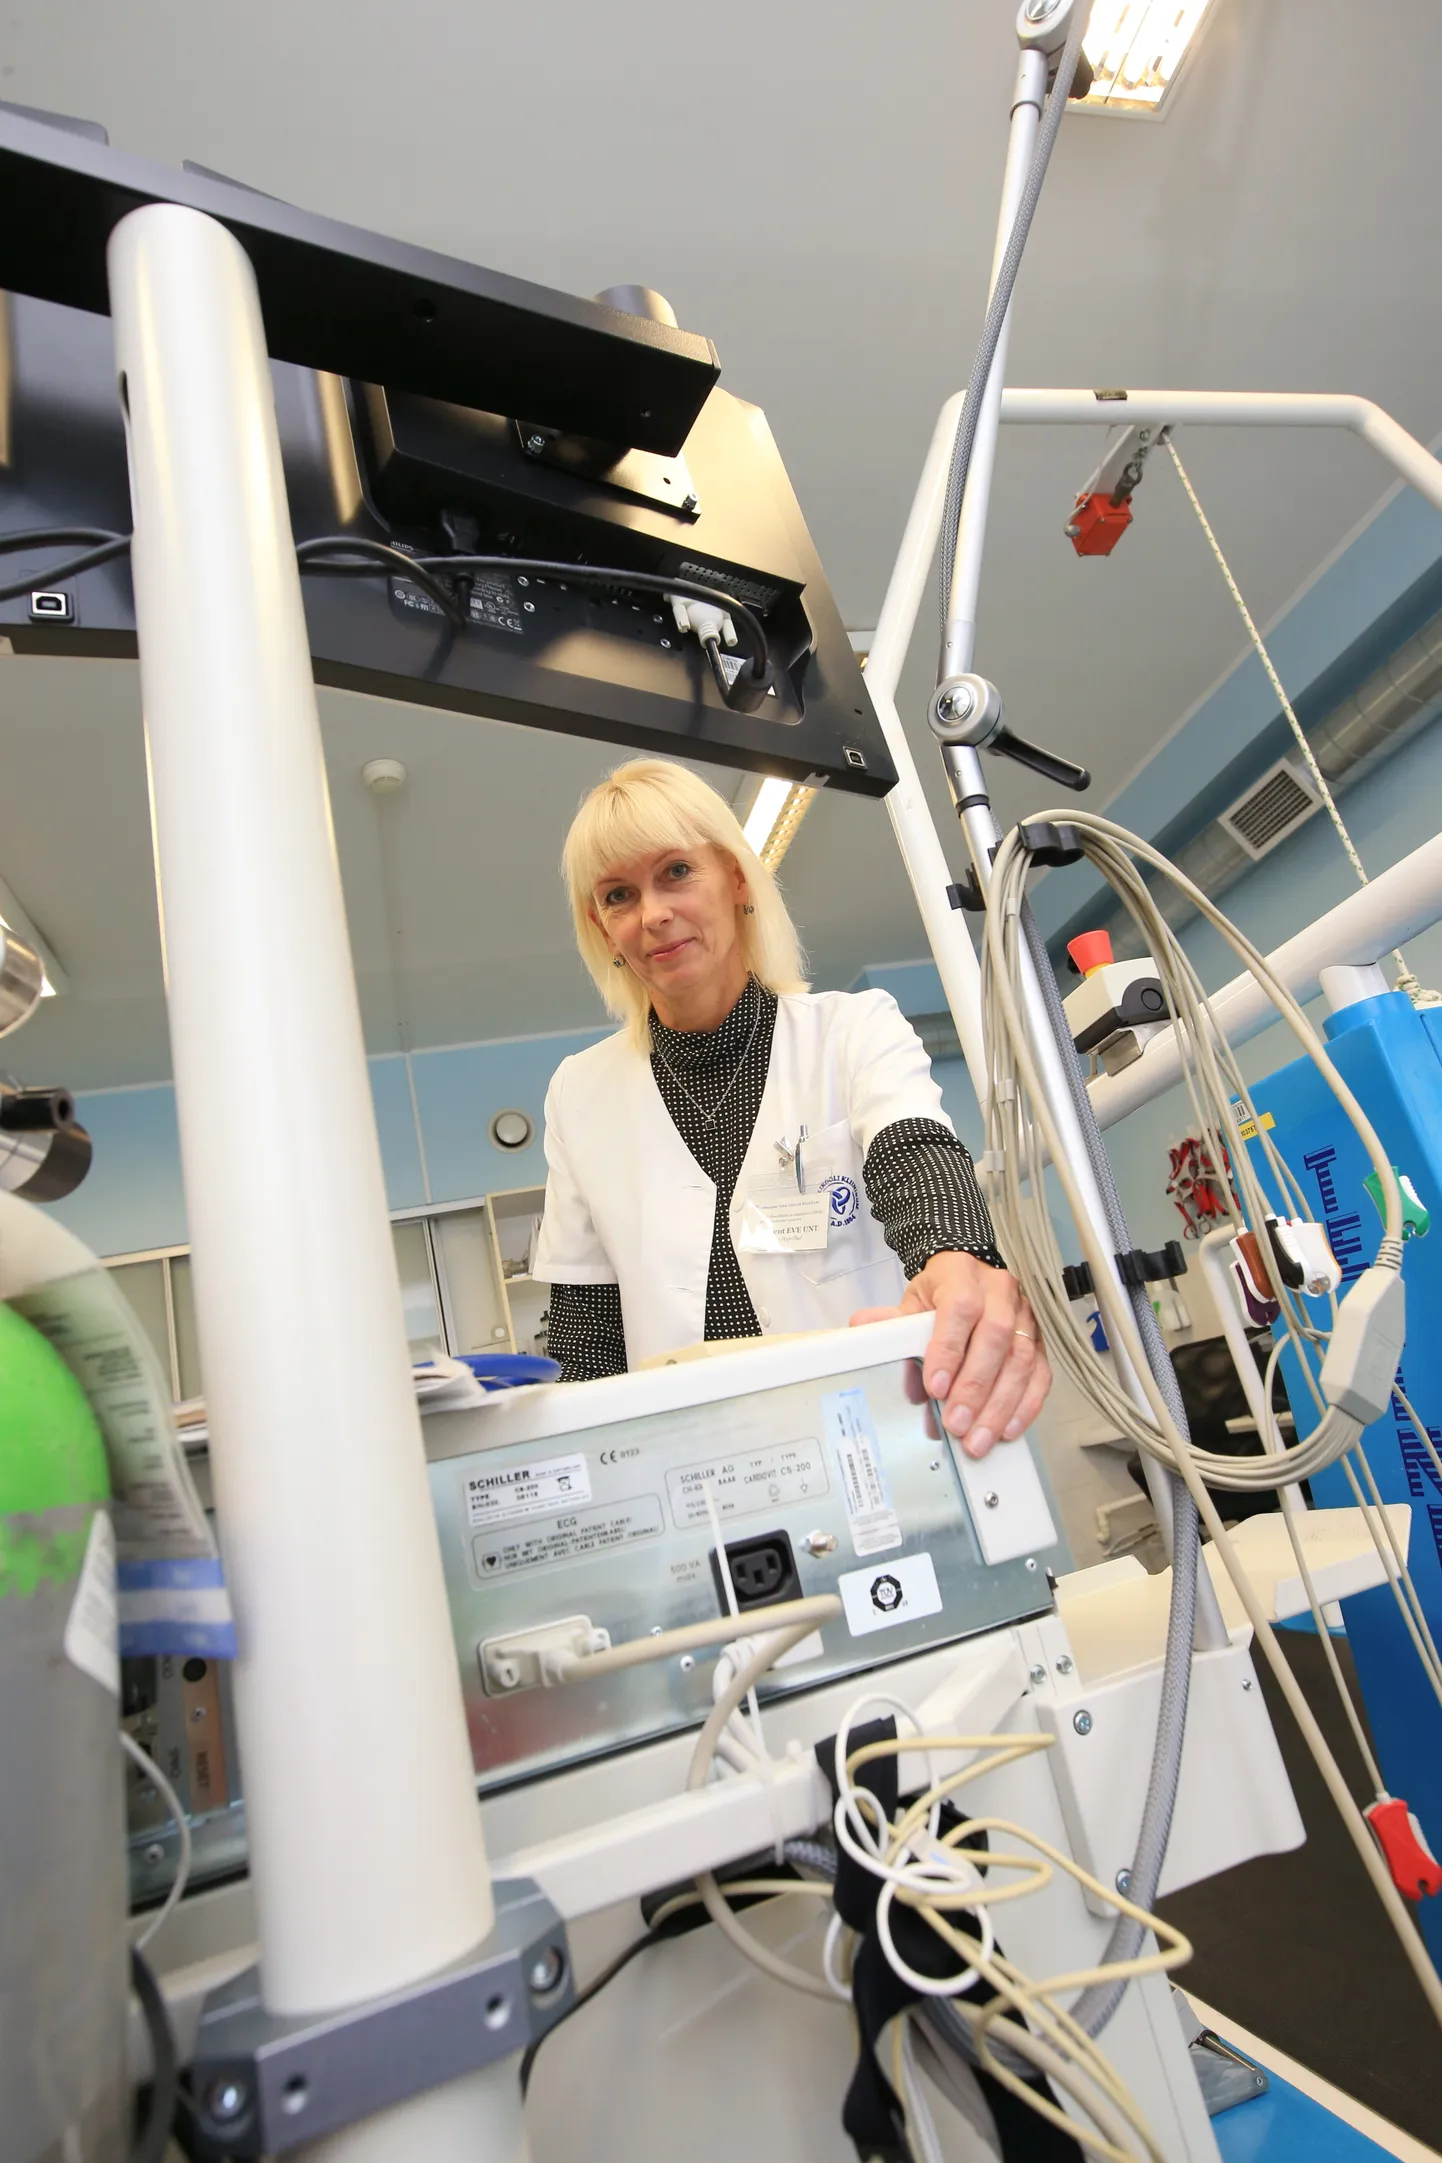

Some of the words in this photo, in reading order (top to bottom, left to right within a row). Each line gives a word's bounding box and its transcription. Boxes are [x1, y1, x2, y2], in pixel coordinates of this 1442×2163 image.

[786, 1226, 801, 1234] EVE
[803, 1225, 819, 1233] UNT
[469, 1470, 531, 1492] SCHILLER
[680, 1468, 715, 1484] SCHILLER
[722, 1464, 734, 1474] AG
[557, 1516, 578, 1529] ECG
